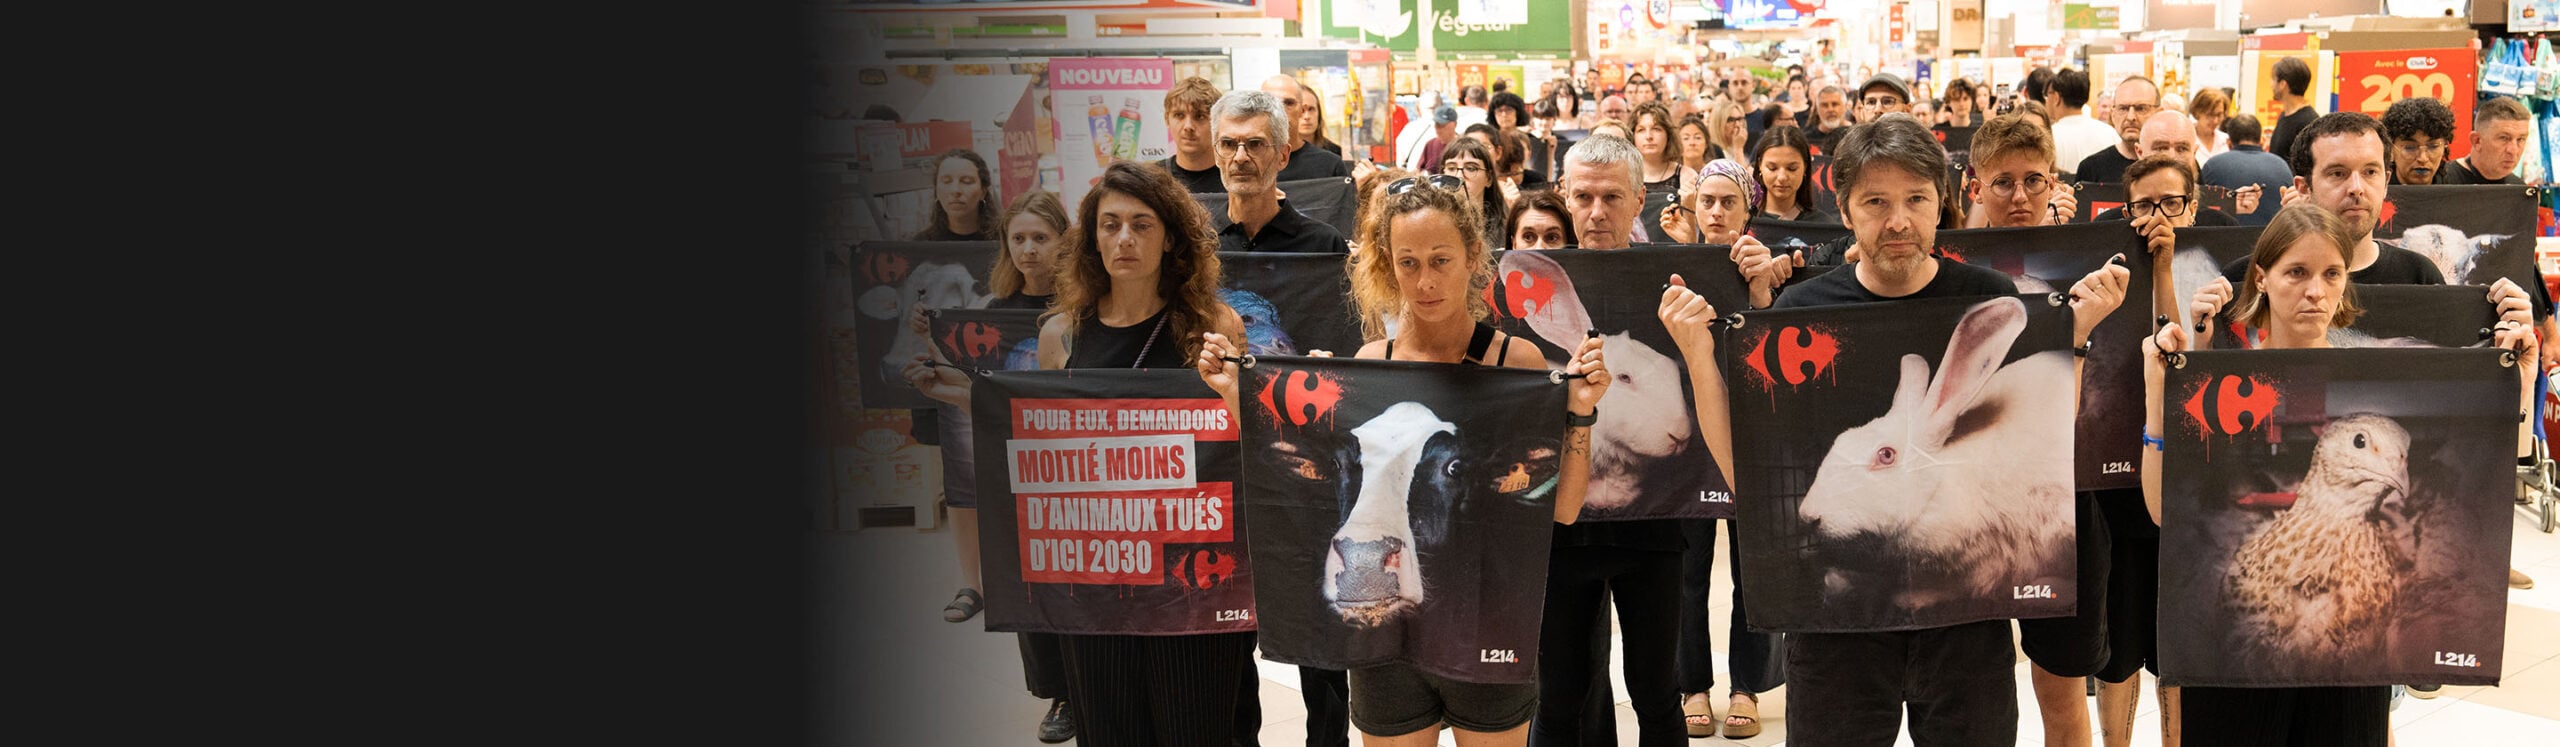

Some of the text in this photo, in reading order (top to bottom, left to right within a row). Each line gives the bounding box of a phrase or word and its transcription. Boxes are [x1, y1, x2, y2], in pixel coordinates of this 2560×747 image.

[1060, 68, 1162, 85] NOUVEAU
[2375, 60, 2395, 68] Avec
[2361, 72, 2455, 113] 200
[1022, 408, 1229, 433] POUR EUX, DEMANDONS
[1016, 442, 1186, 484] MOITIÉ MOINS
[1027, 492, 1223, 532] D'ANIMAUX TUÉS
[1029, 538, 1152, 575] D'ICI 2030
